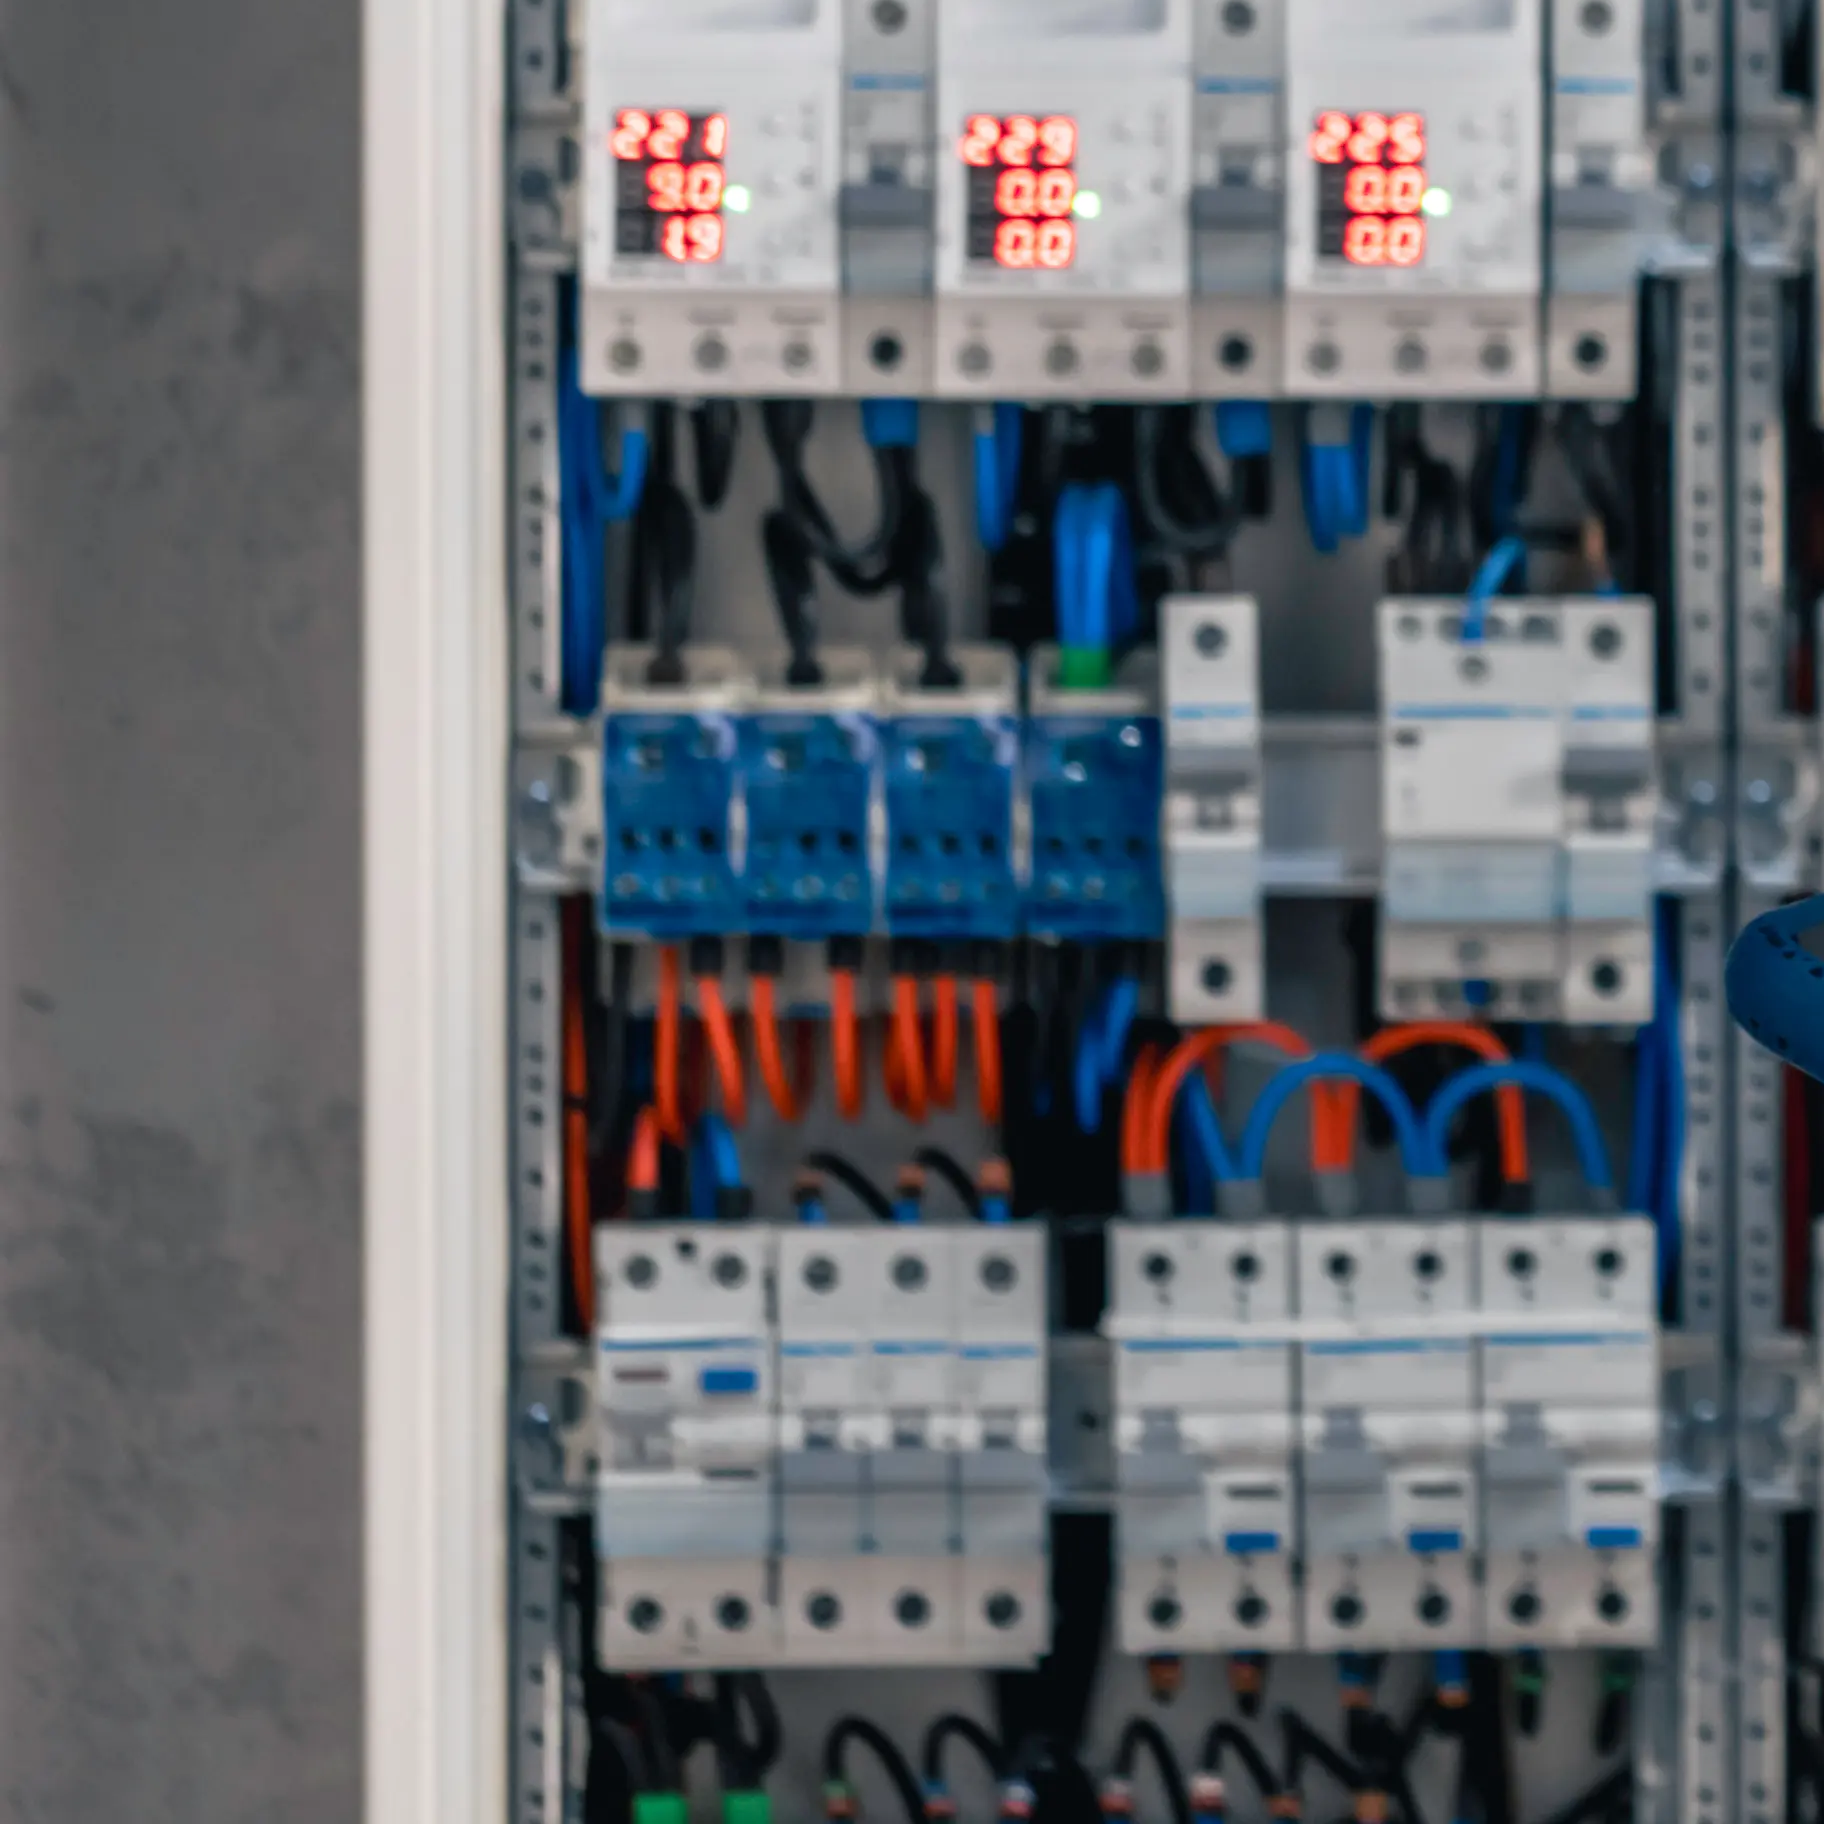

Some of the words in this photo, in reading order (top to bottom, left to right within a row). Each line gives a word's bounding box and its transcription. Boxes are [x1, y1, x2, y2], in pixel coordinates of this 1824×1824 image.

[608, 109, 728, 160] 221
[957, 114, 1077, 166] 229
[1309, 110, 1426, 163] 225
